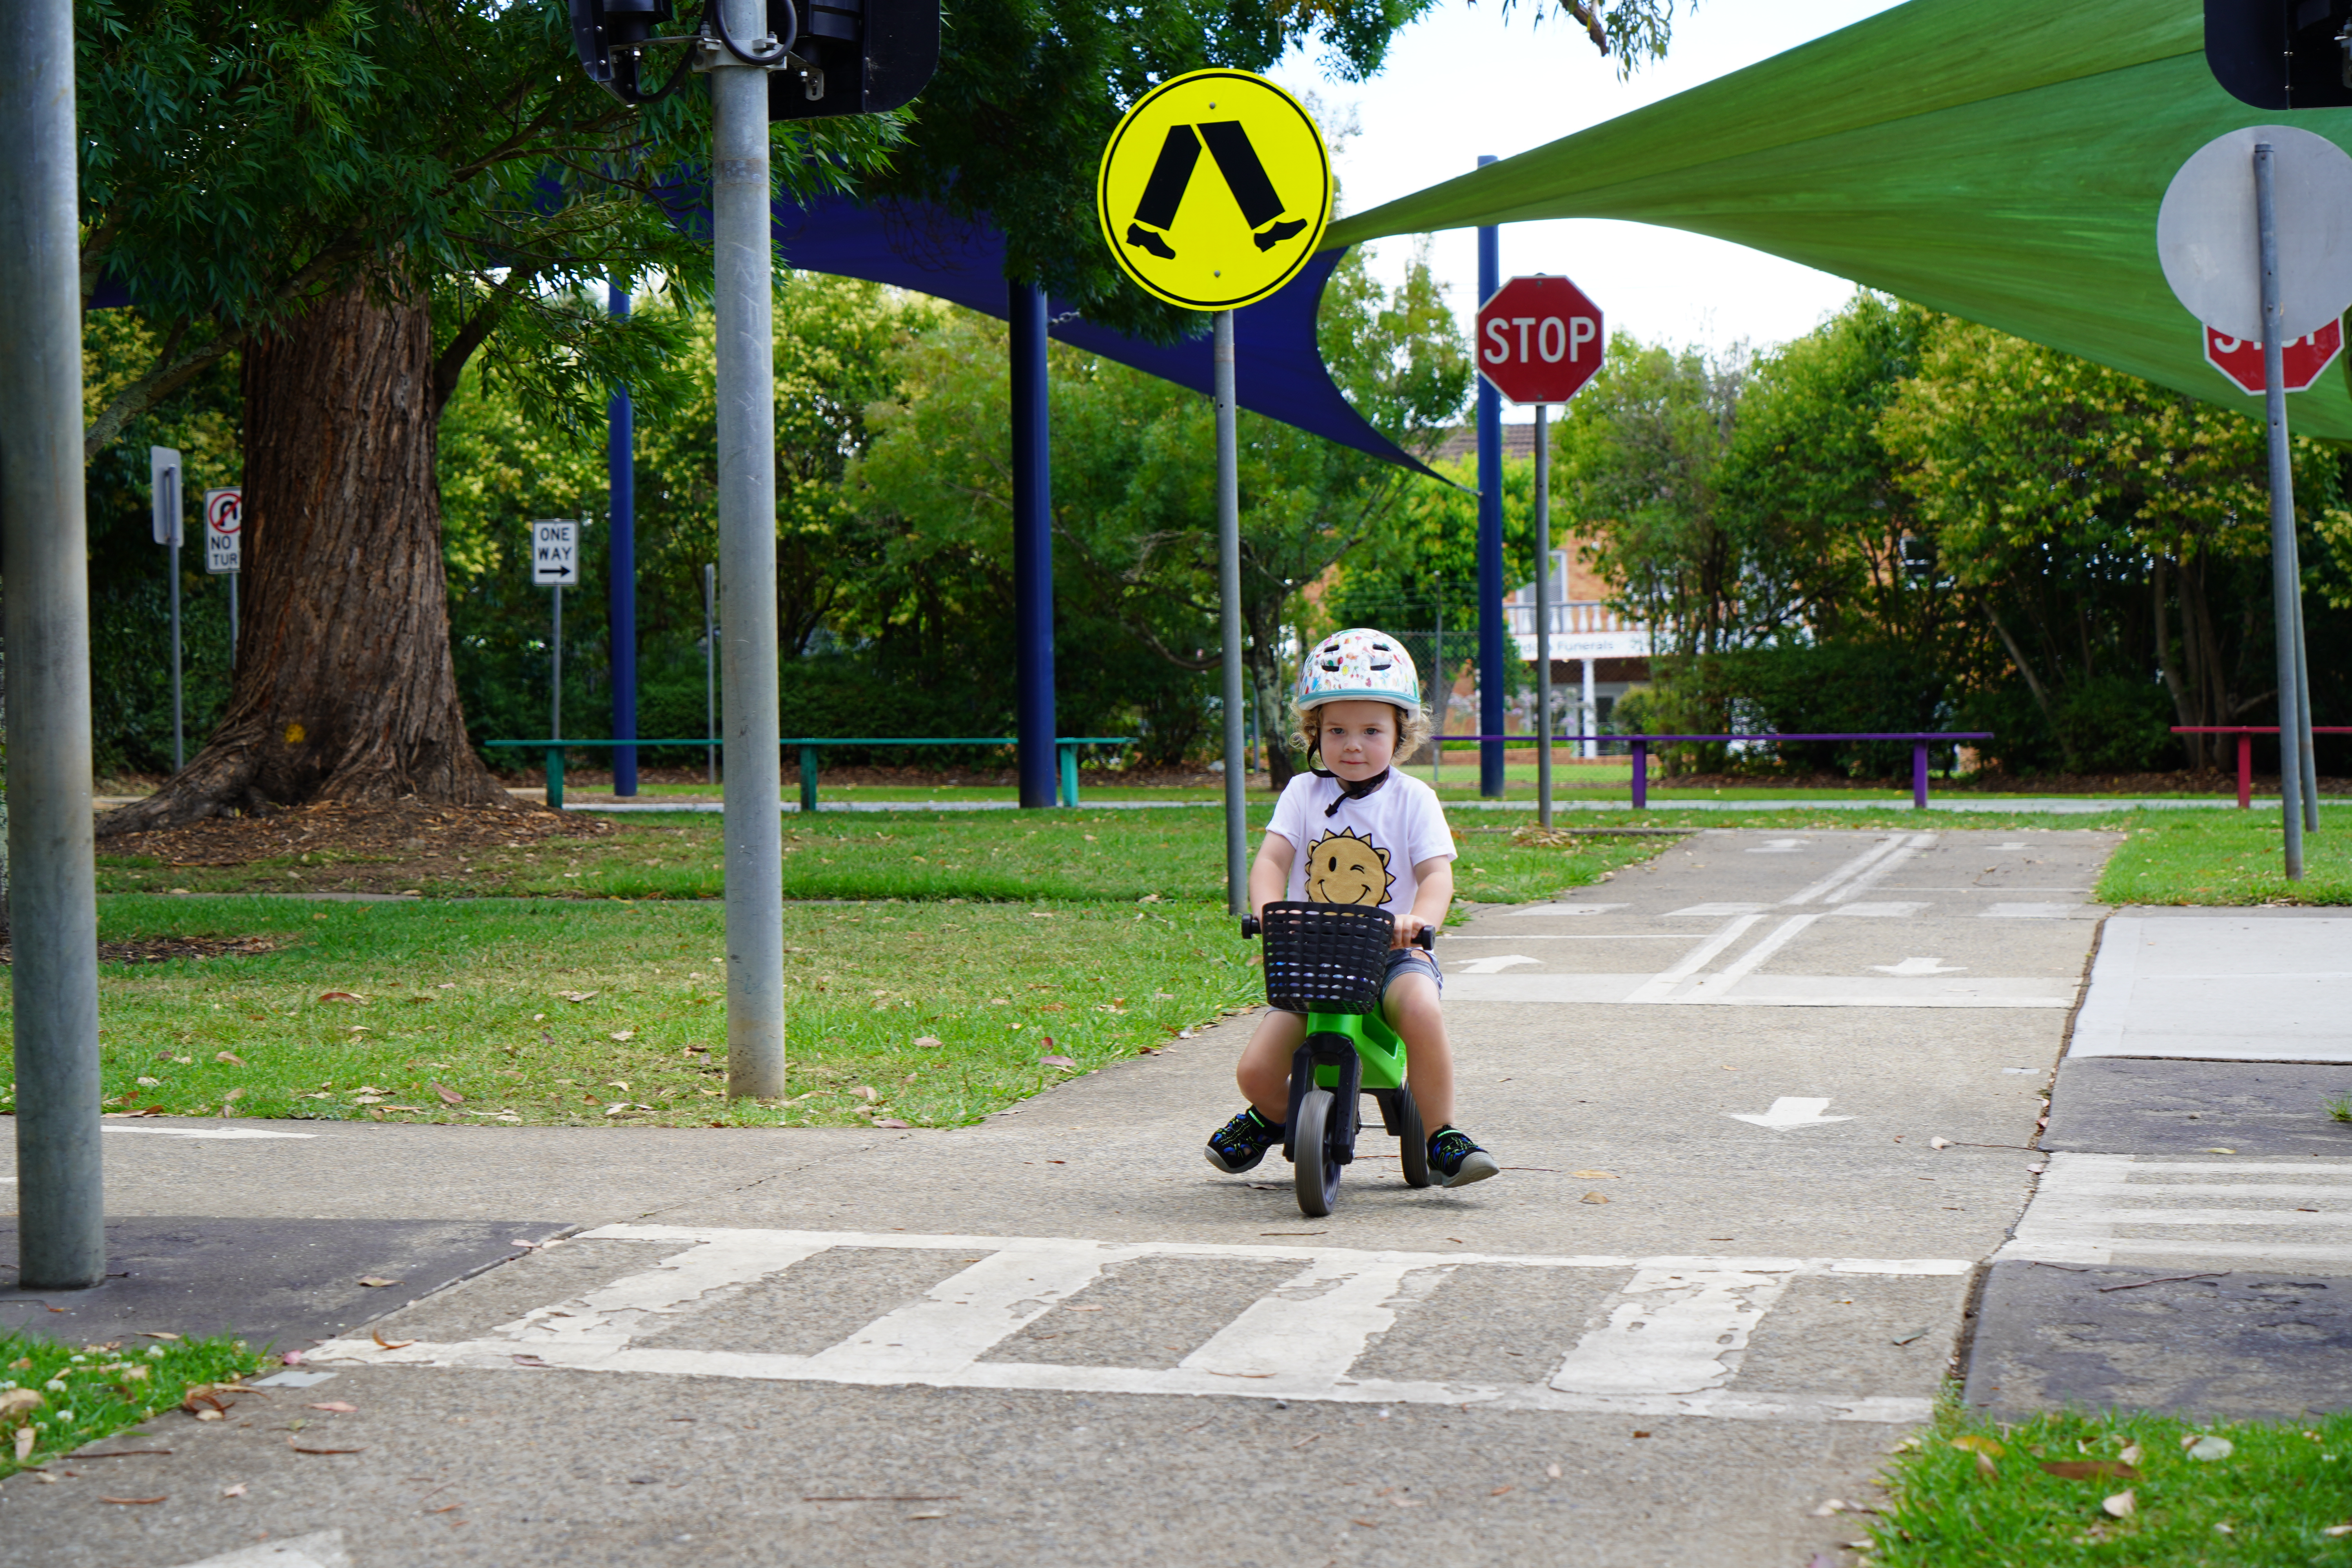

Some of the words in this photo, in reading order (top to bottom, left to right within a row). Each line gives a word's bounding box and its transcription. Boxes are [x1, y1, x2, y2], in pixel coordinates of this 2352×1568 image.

[1484, 316, 1596, 364] STOP
[540, 527, 570, 542] ONE
[211, 535, 232, 550] NO
[213, 553, 238, 566] TUR
[538, 547, 572, 561] WAY
[1557, 639, 1613, 652] Funerals
